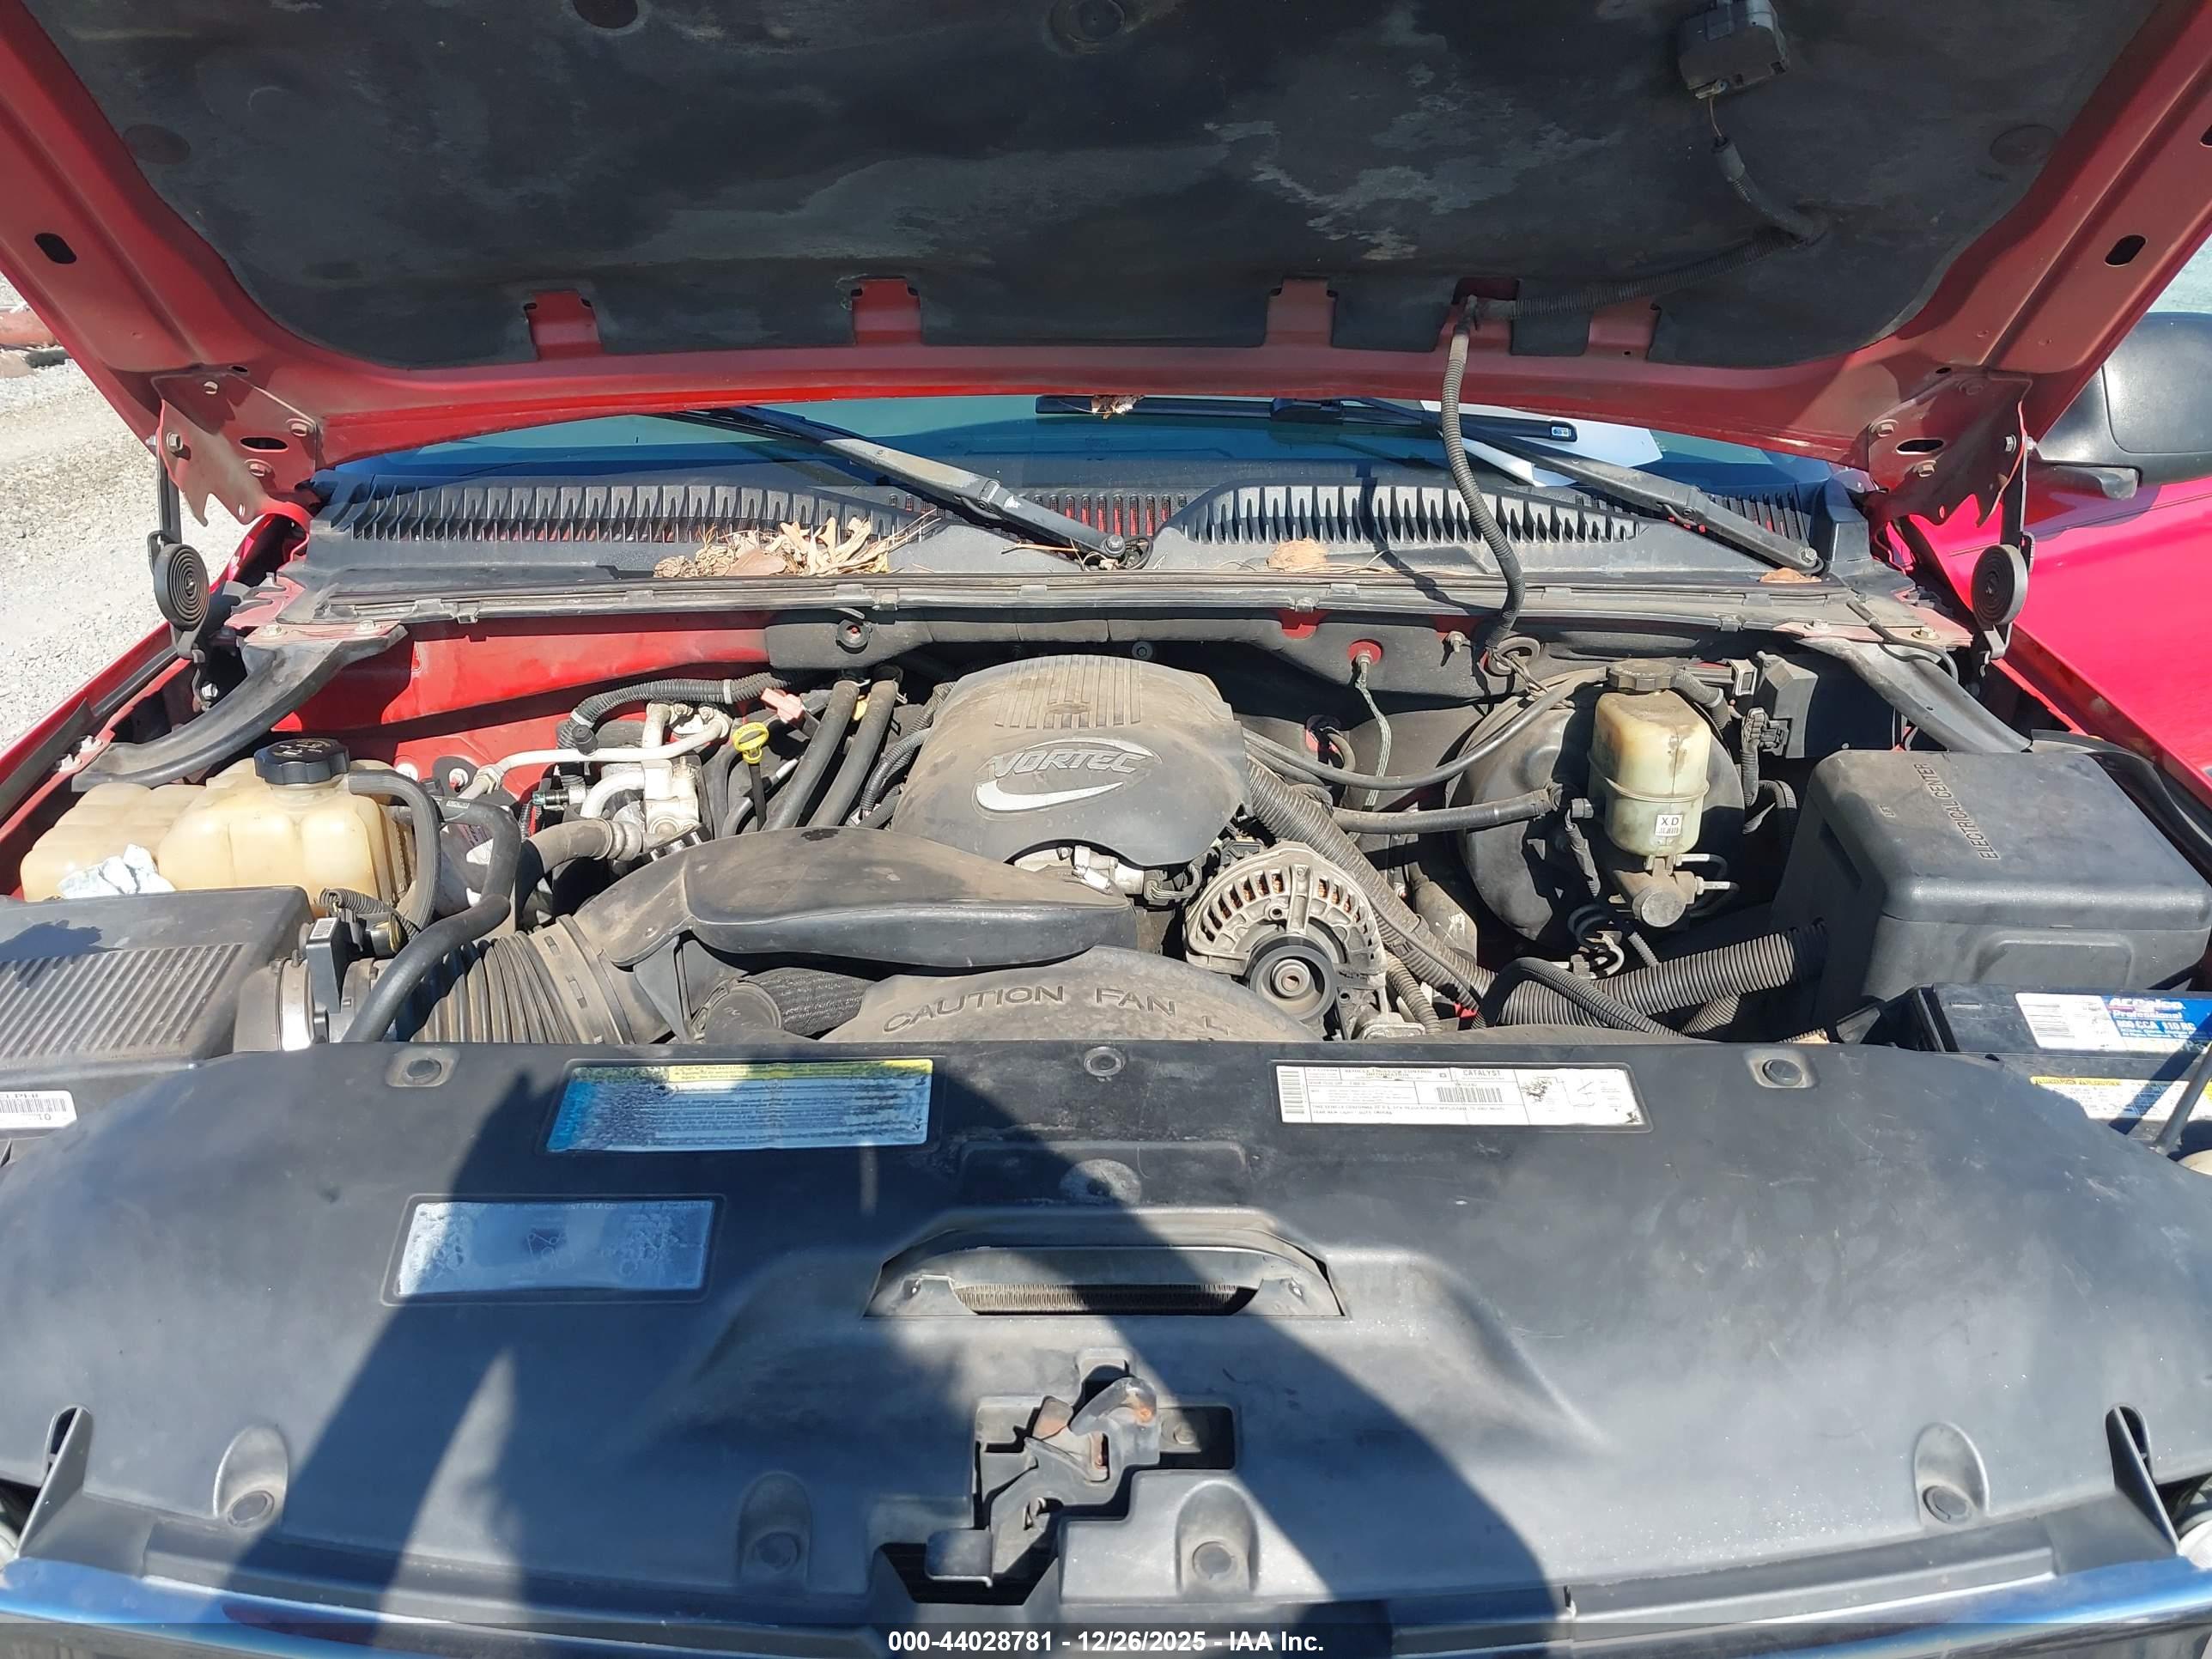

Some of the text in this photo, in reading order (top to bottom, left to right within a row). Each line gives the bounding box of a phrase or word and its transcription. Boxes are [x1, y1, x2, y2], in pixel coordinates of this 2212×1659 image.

[991, 747, 1149, 779] VORTEC
[1913, 763, 2000, 860] ELECTRICAL CENTER
[883, 985, 1177, 1033] CAUTION FAN
